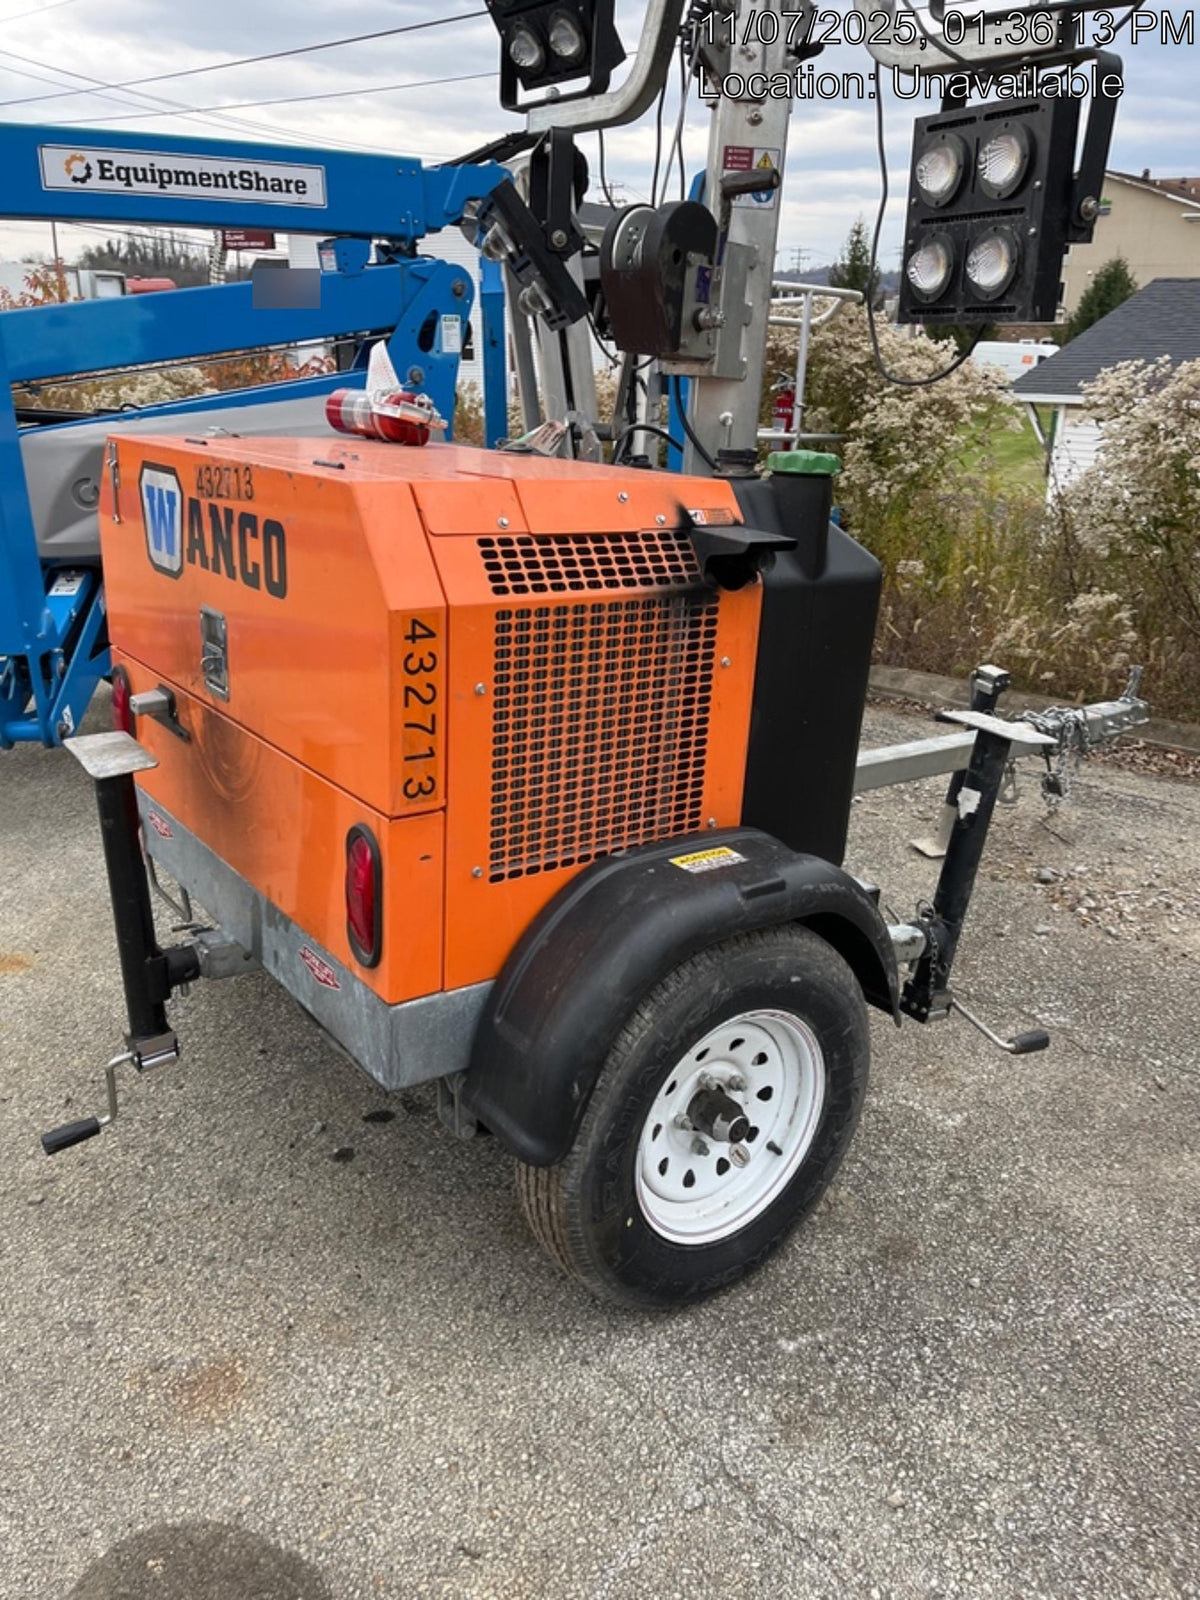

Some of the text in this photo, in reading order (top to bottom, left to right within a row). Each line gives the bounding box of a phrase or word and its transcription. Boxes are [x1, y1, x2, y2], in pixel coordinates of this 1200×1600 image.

[98, 158, 308, 196] EquipmentShare
[197, 466, 255, 502] 432713
[146, 484, 288, 599] WANCO
[403, 617, 437, 800] 432713
